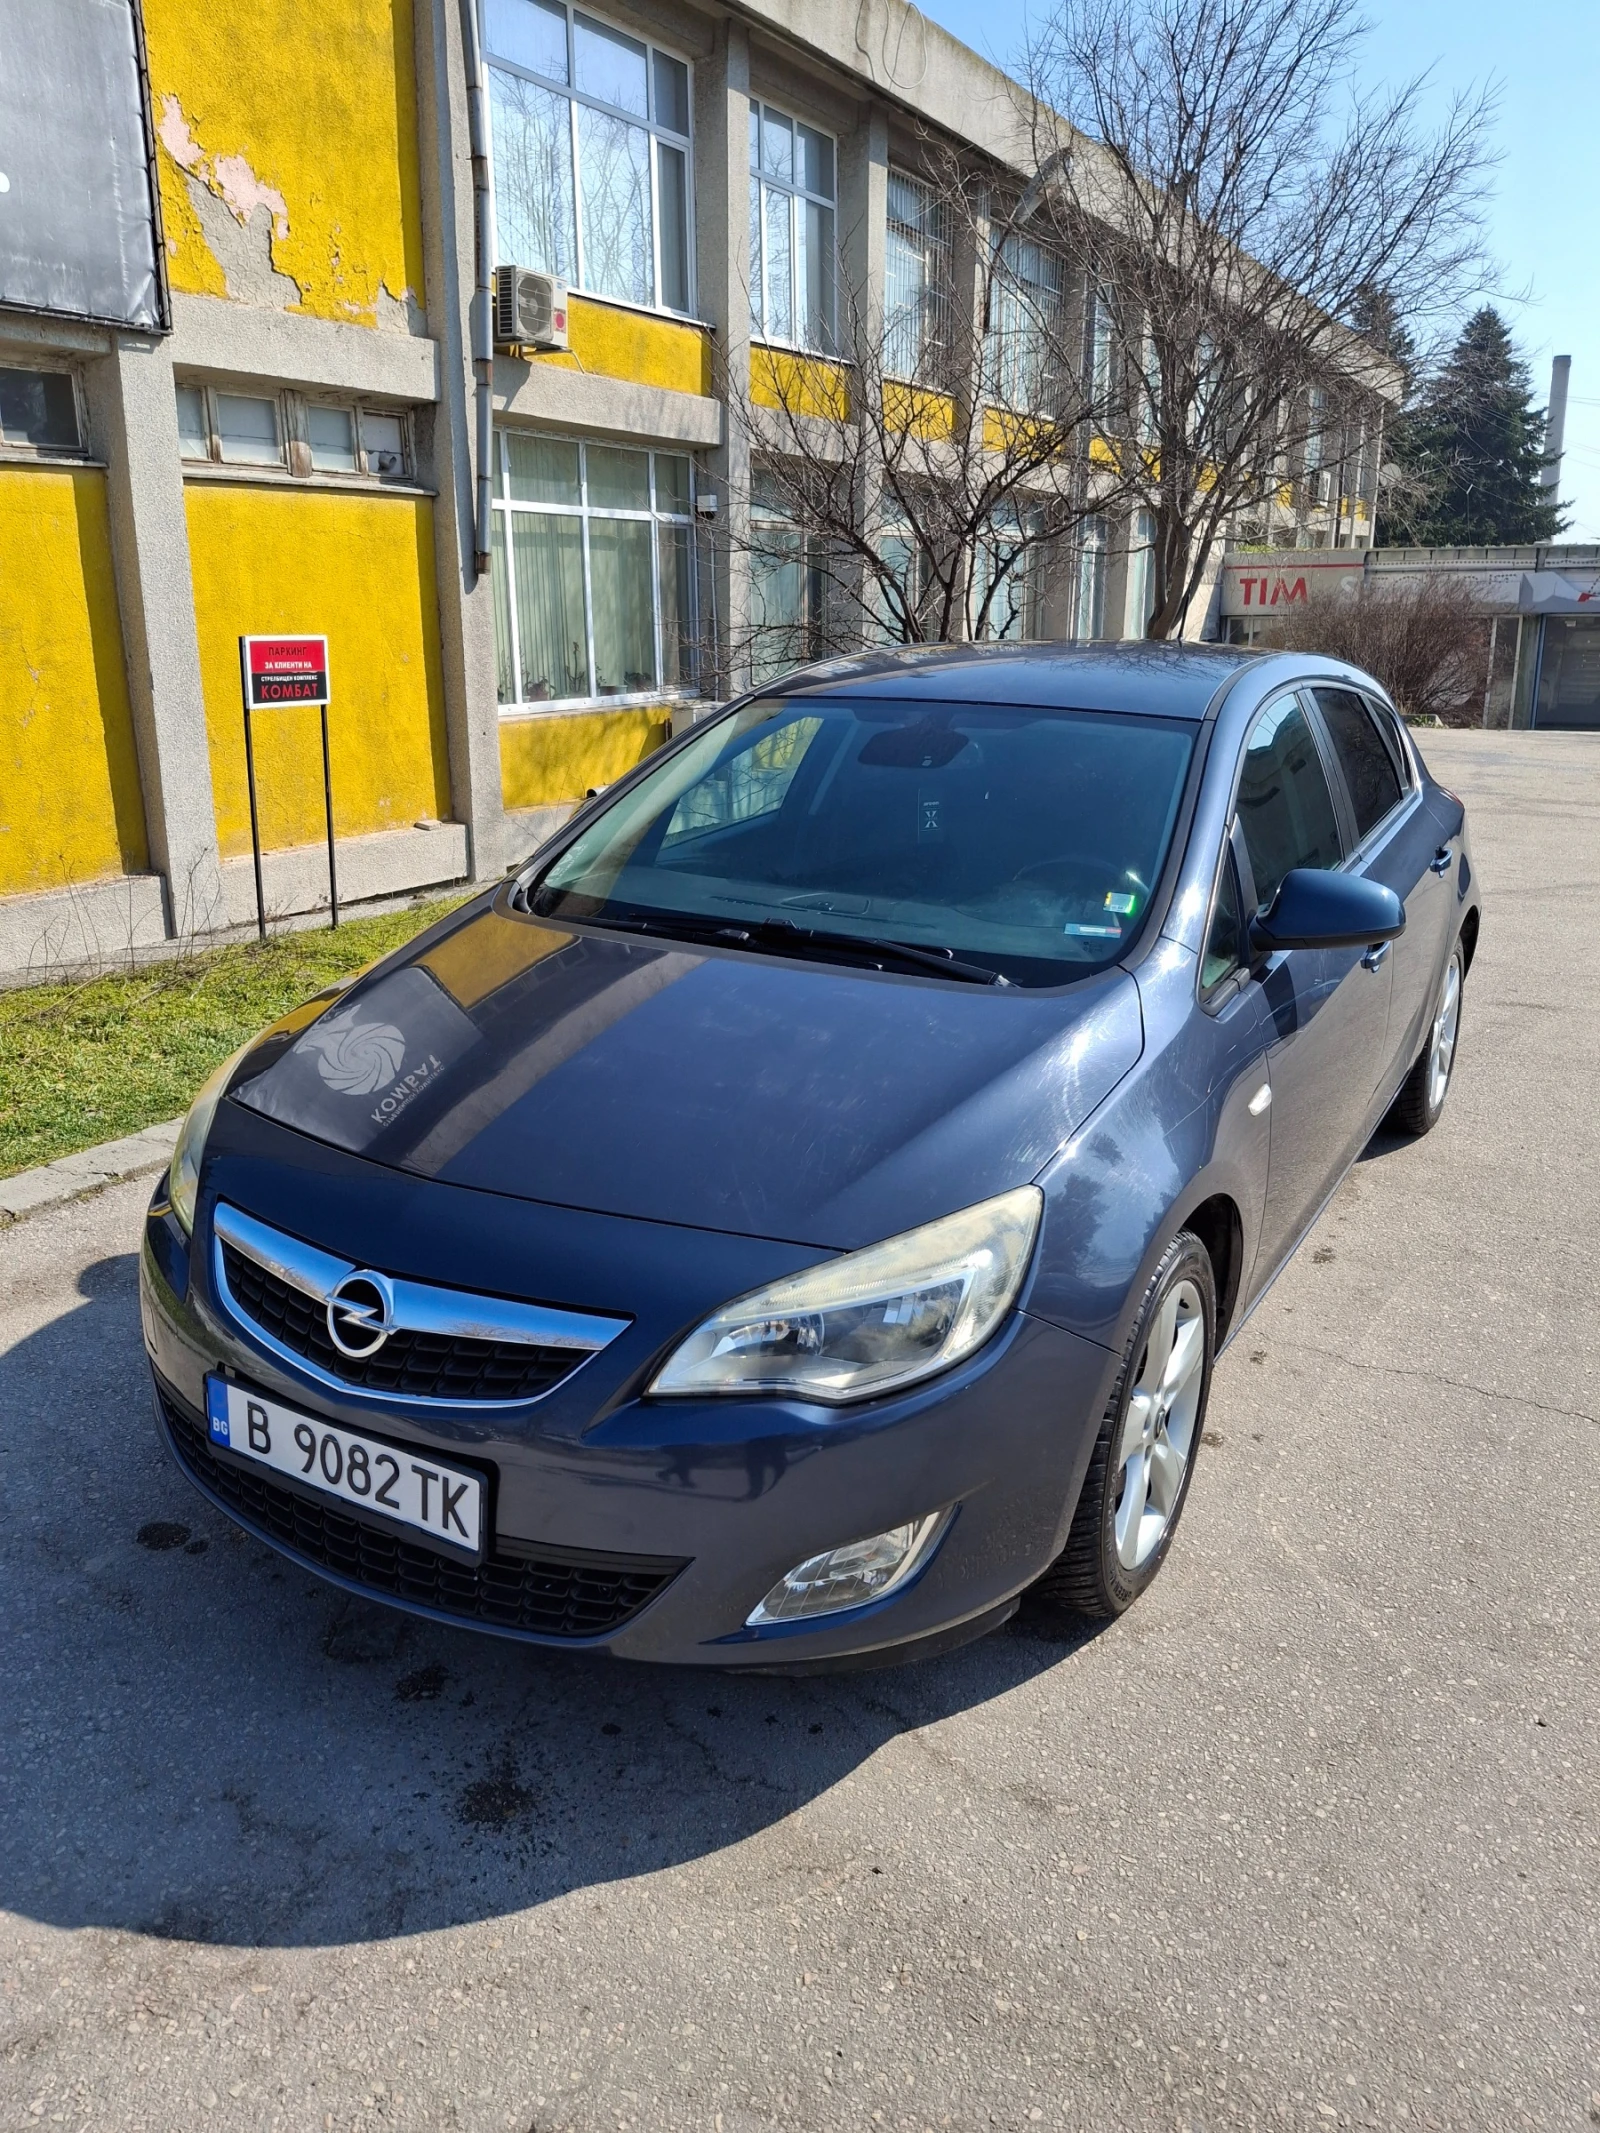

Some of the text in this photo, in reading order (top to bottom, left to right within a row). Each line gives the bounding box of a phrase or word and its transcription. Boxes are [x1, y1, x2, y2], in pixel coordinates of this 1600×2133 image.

[1240, 577, 1308, 605] TIM
[268, 647, 307, 656] ПАРКИНГ
[274, 661, 303, 669] КЛИЕНТИ
[303, 661, 313, 669] НА
[261, 683, 318, 699] КОМБАТ
[212, 1416, 229, 1436] BG
[246, 1400, 271, 1455] B
[294, 1424, 400, 1510] 9082
